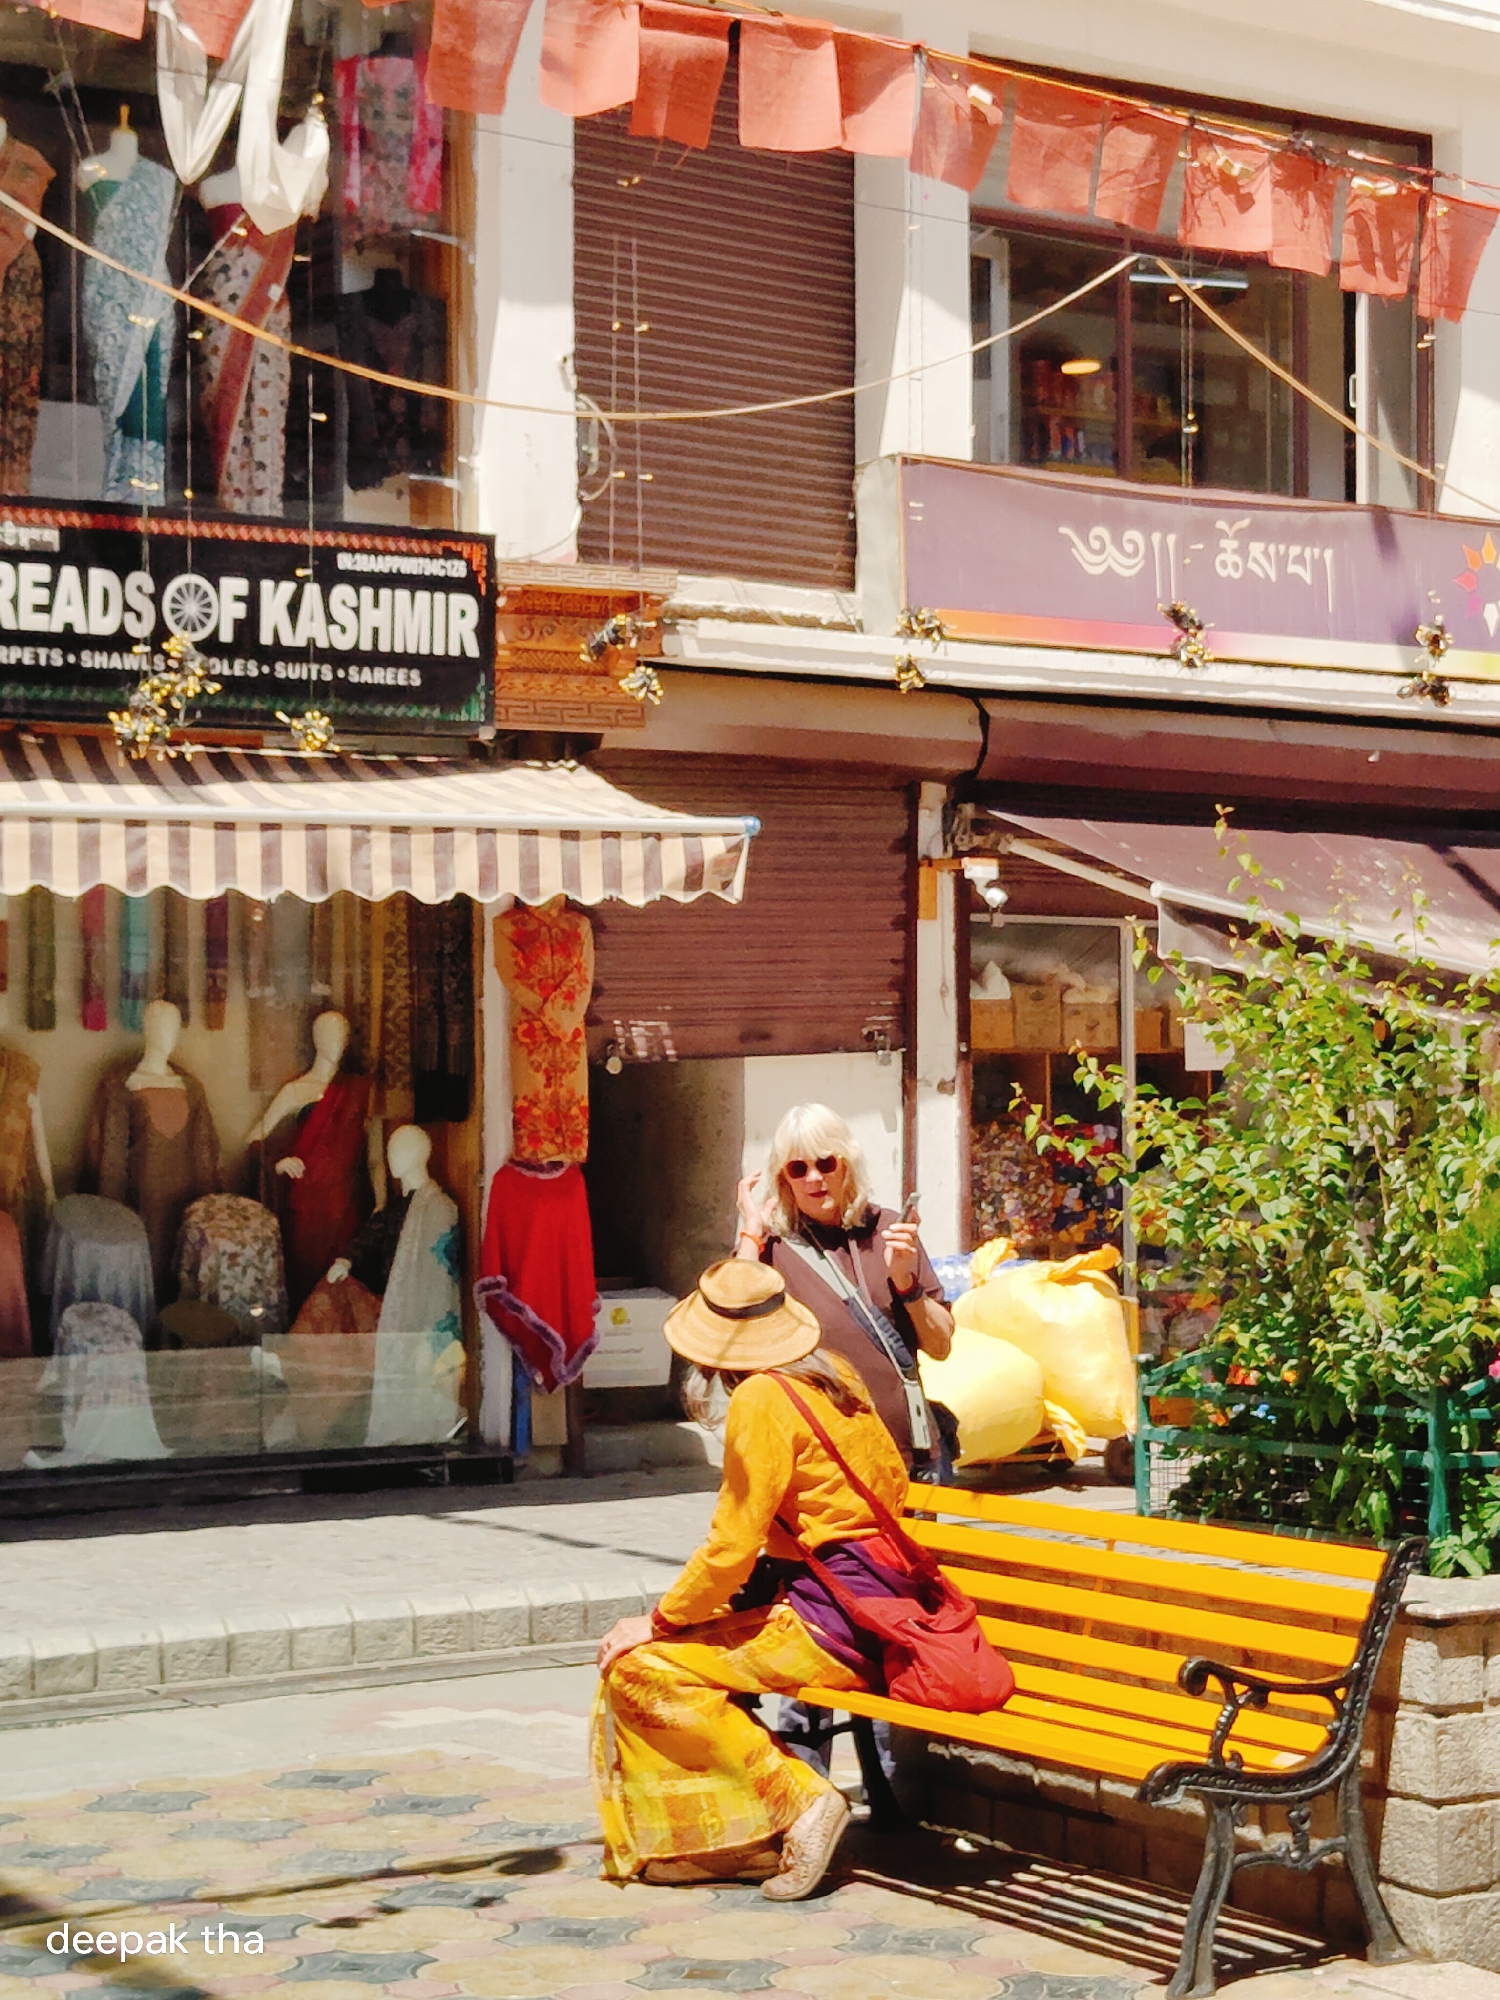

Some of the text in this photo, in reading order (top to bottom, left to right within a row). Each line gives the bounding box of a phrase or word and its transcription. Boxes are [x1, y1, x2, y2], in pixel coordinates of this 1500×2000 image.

[259, 579, 481, 658] KASHMIR
[80, 649, 167, 671] SHAWLS
[274, 661, 334, 681] SUITS
[348, 664, 422, 687] SAREES
